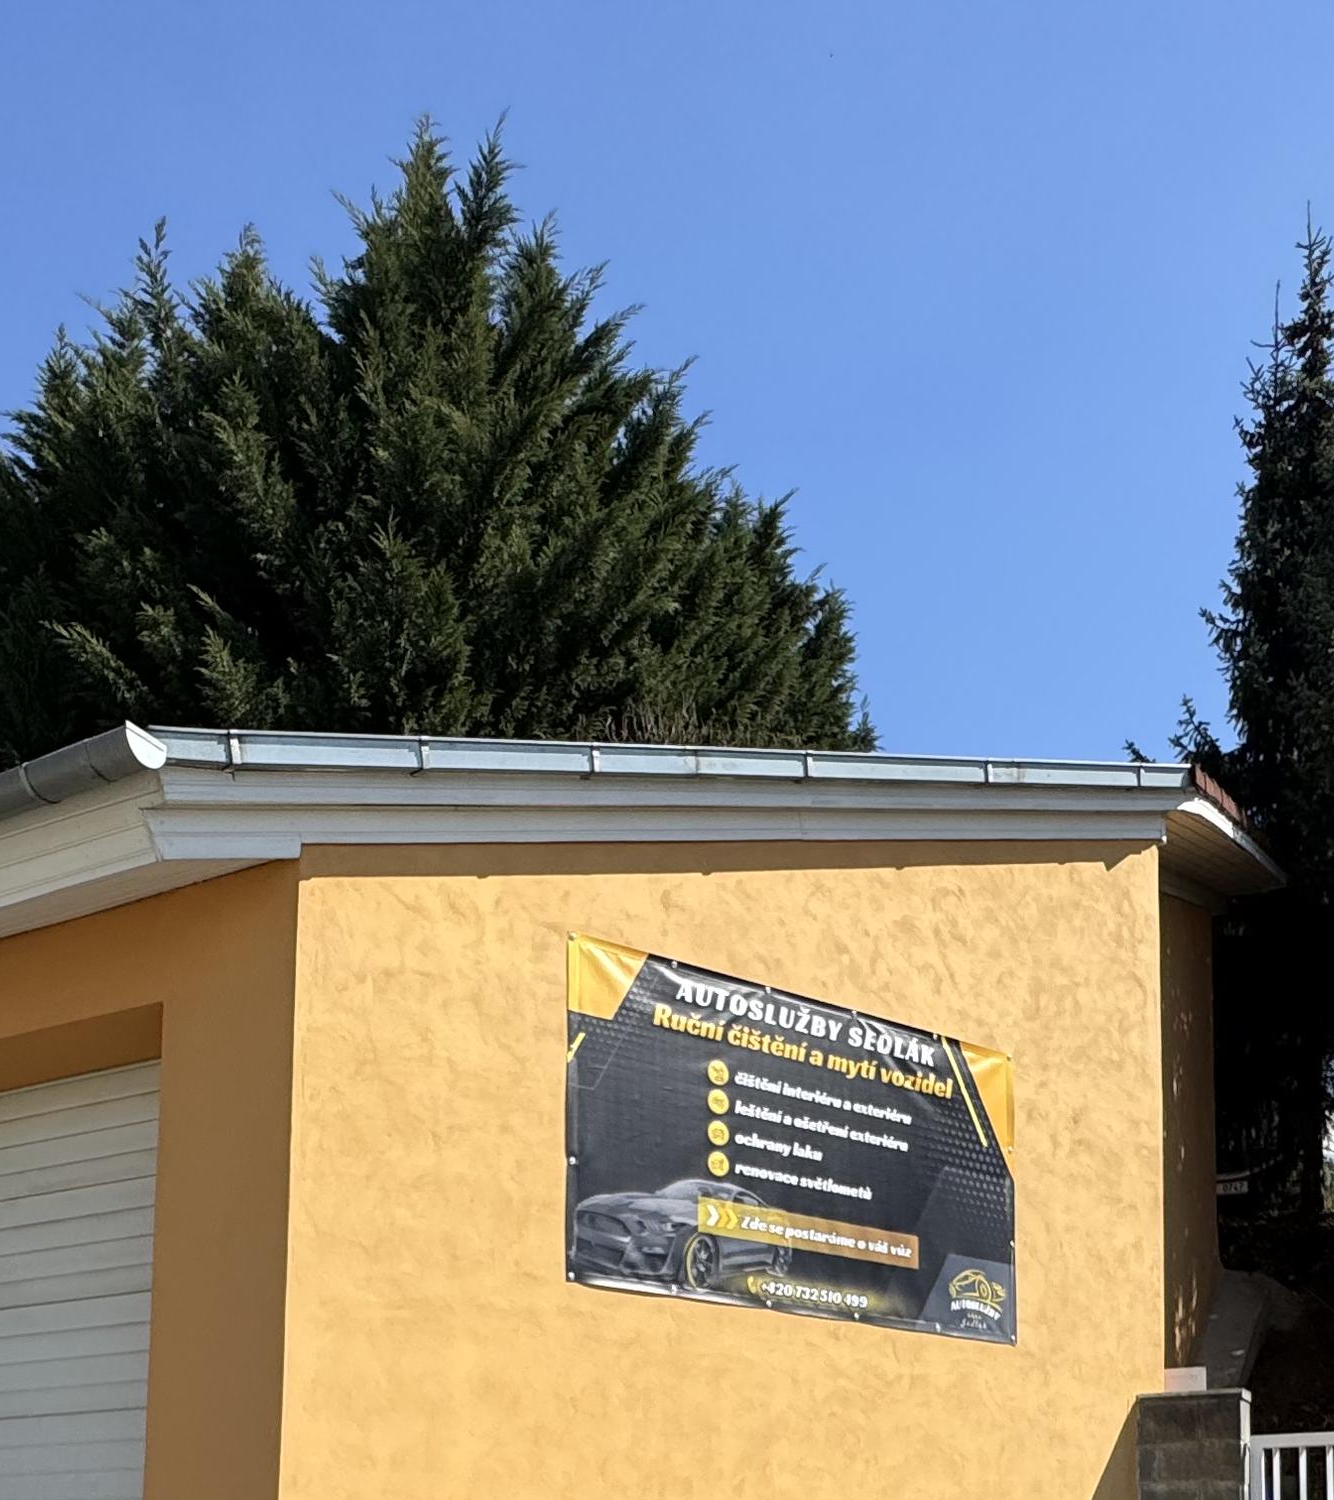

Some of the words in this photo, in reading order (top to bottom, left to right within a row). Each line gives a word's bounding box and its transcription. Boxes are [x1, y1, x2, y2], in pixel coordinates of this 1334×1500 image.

[676, 981, 842, 1042] AUTOSLUŽBY
[848, 1027, 935, 1067] SEDLÁK
[652, 1003, 726, 1042] Ruční
[727, 1022, 808, 1062] čištění
[809, 1049, 824, 1067] a
[827, 1054, 878, 1081] mytí
[880, 1067, 954, 1100] vozidel
[783, 1114, 793, 1126] a
[842, 1100, 852, 1111] a
[734, 1132, 792, 1158] ochrany
[792, 1141, 823, 1162] laku
[734, 1163, 799, 1186] renovace
[741, 1215, 768, 1232] Zde
[768, 1223, 785, 1236] se
[785, 1225, 856, 1249] postaráme
[856, 1239, 867, 1250] o
[867, 1239, 889, 1255] váš
[890, 1243, 913, 1259] vůz
[761, 1280, 793, 1297] +420
[794, 1285, 818, 1302] 732
[819, 1289, 844, 1306] 510
[844, 1293, 869, 1309] 499
